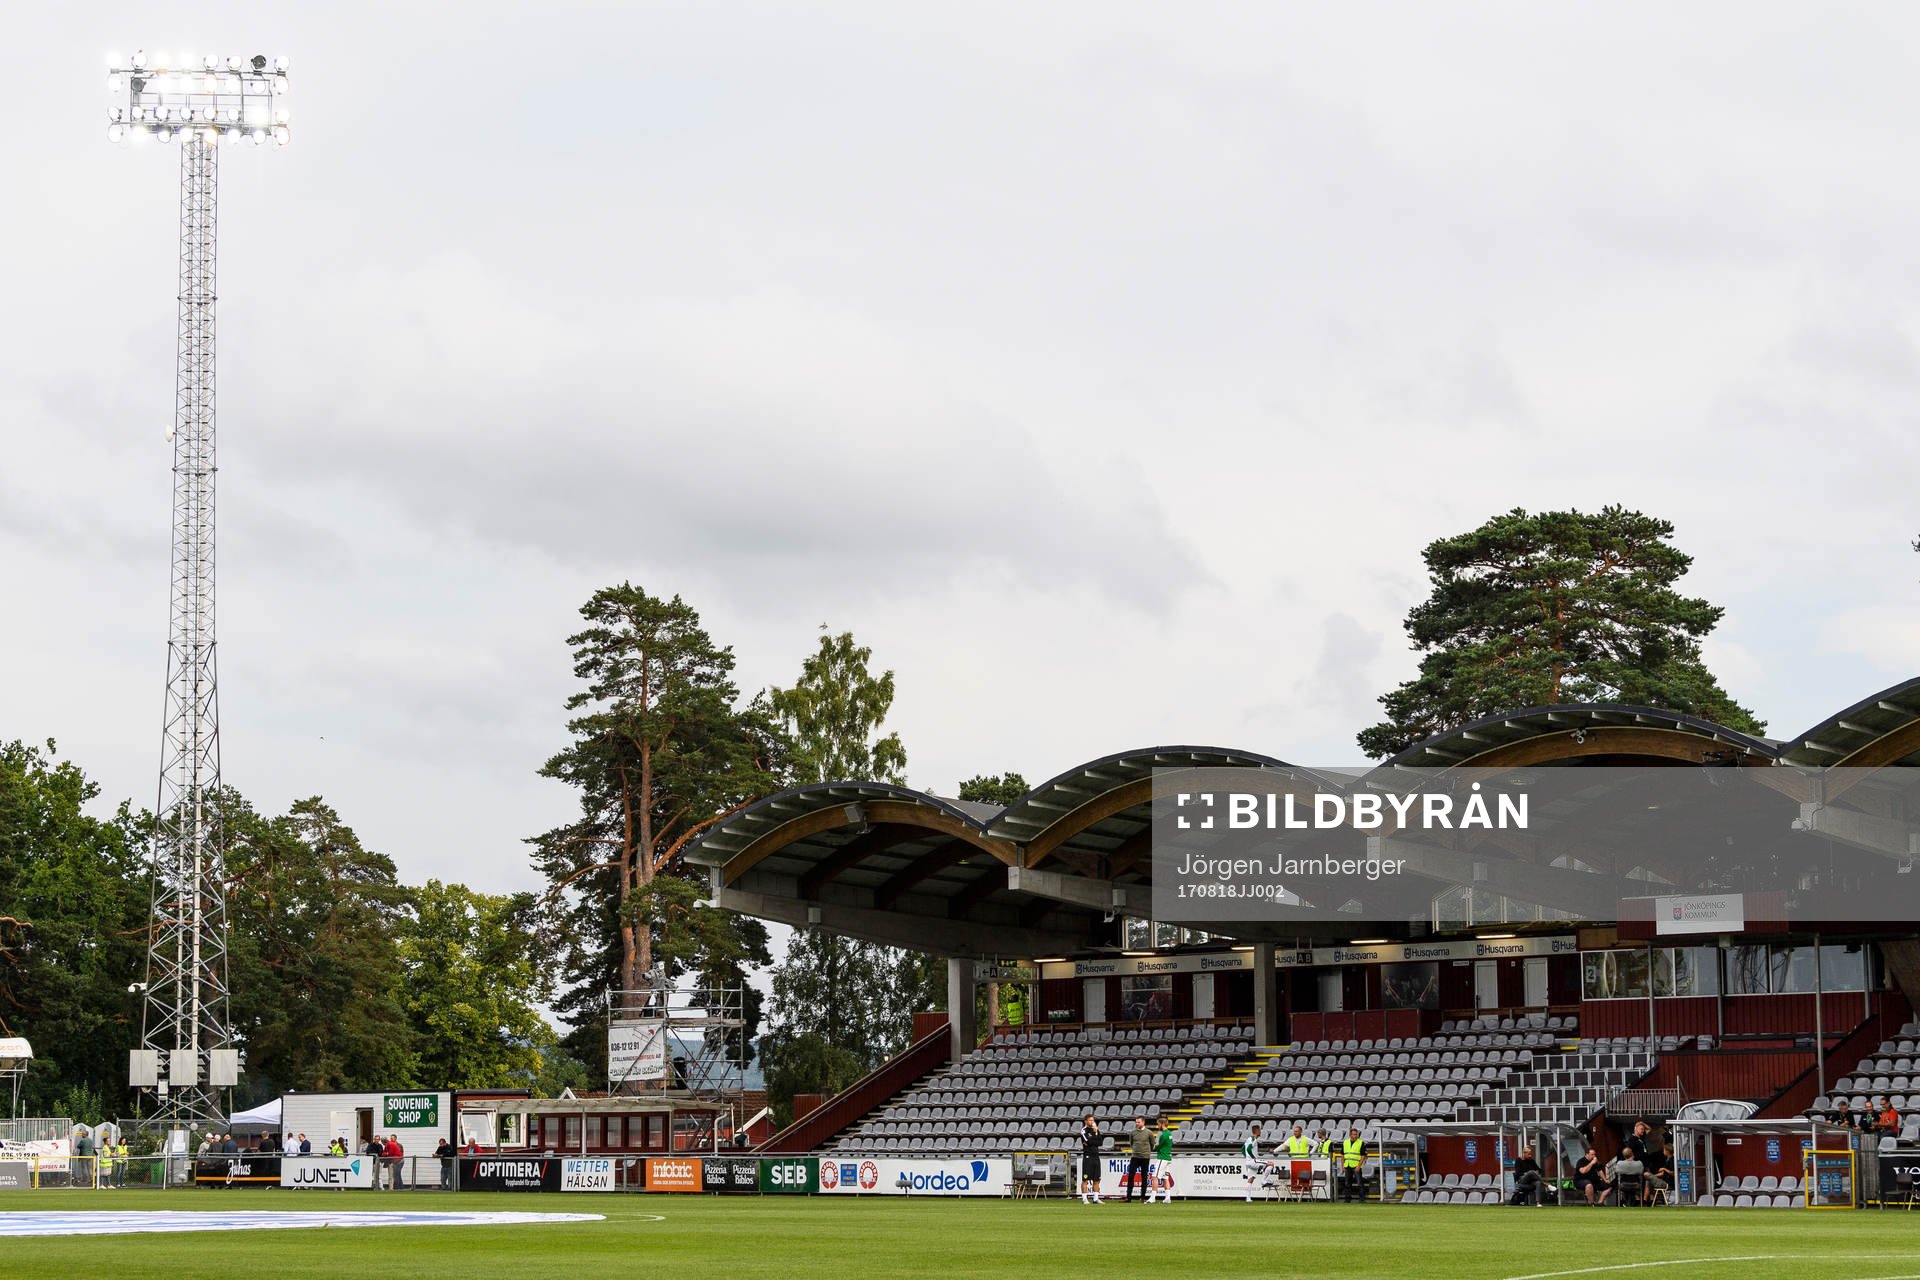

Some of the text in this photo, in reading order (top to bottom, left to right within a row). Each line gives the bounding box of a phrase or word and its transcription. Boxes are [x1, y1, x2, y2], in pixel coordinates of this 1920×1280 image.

[1684, 901, 1725, 911] JÖNKÖPINGS
[1684, 911, 1718, 920] KOMMUN
[1411, 947, 1449, 958] Husqvarna
[1485, 943, 1524, 954] Husqvarna
[1298, 953, 1311, 962] A B
[1341, 951, 1378, 961] Husqvarna
[1144, 961, 1177, 972] Husqvarna
[1207, 958, 1242, 968] Husqvarna
[1082, 964, 1115, 974] Husqvarna
[1588, 969, 1594, 979] 2
[388, 1098, 433, 1110] SOUVENIR-
[398, 1111, 421, 1123] SHOP
[479, 1161, 541, 1178] OPTIMERA
[567, 1160, 609, 1173] WETTER
[705, 1164, 727, 1174] Pizzeria
[733, 1164, 755, 1175] Pizzeria
[1193, 1165, 1242, 1175] KONTORS
[294, 1168, 353, 1184] JUNET
[771, 1165, 807, 1185] SEB
[900, 1170, 970, 1190] Nordea
[566, 1174, 608, 1188] HÄLSAN
